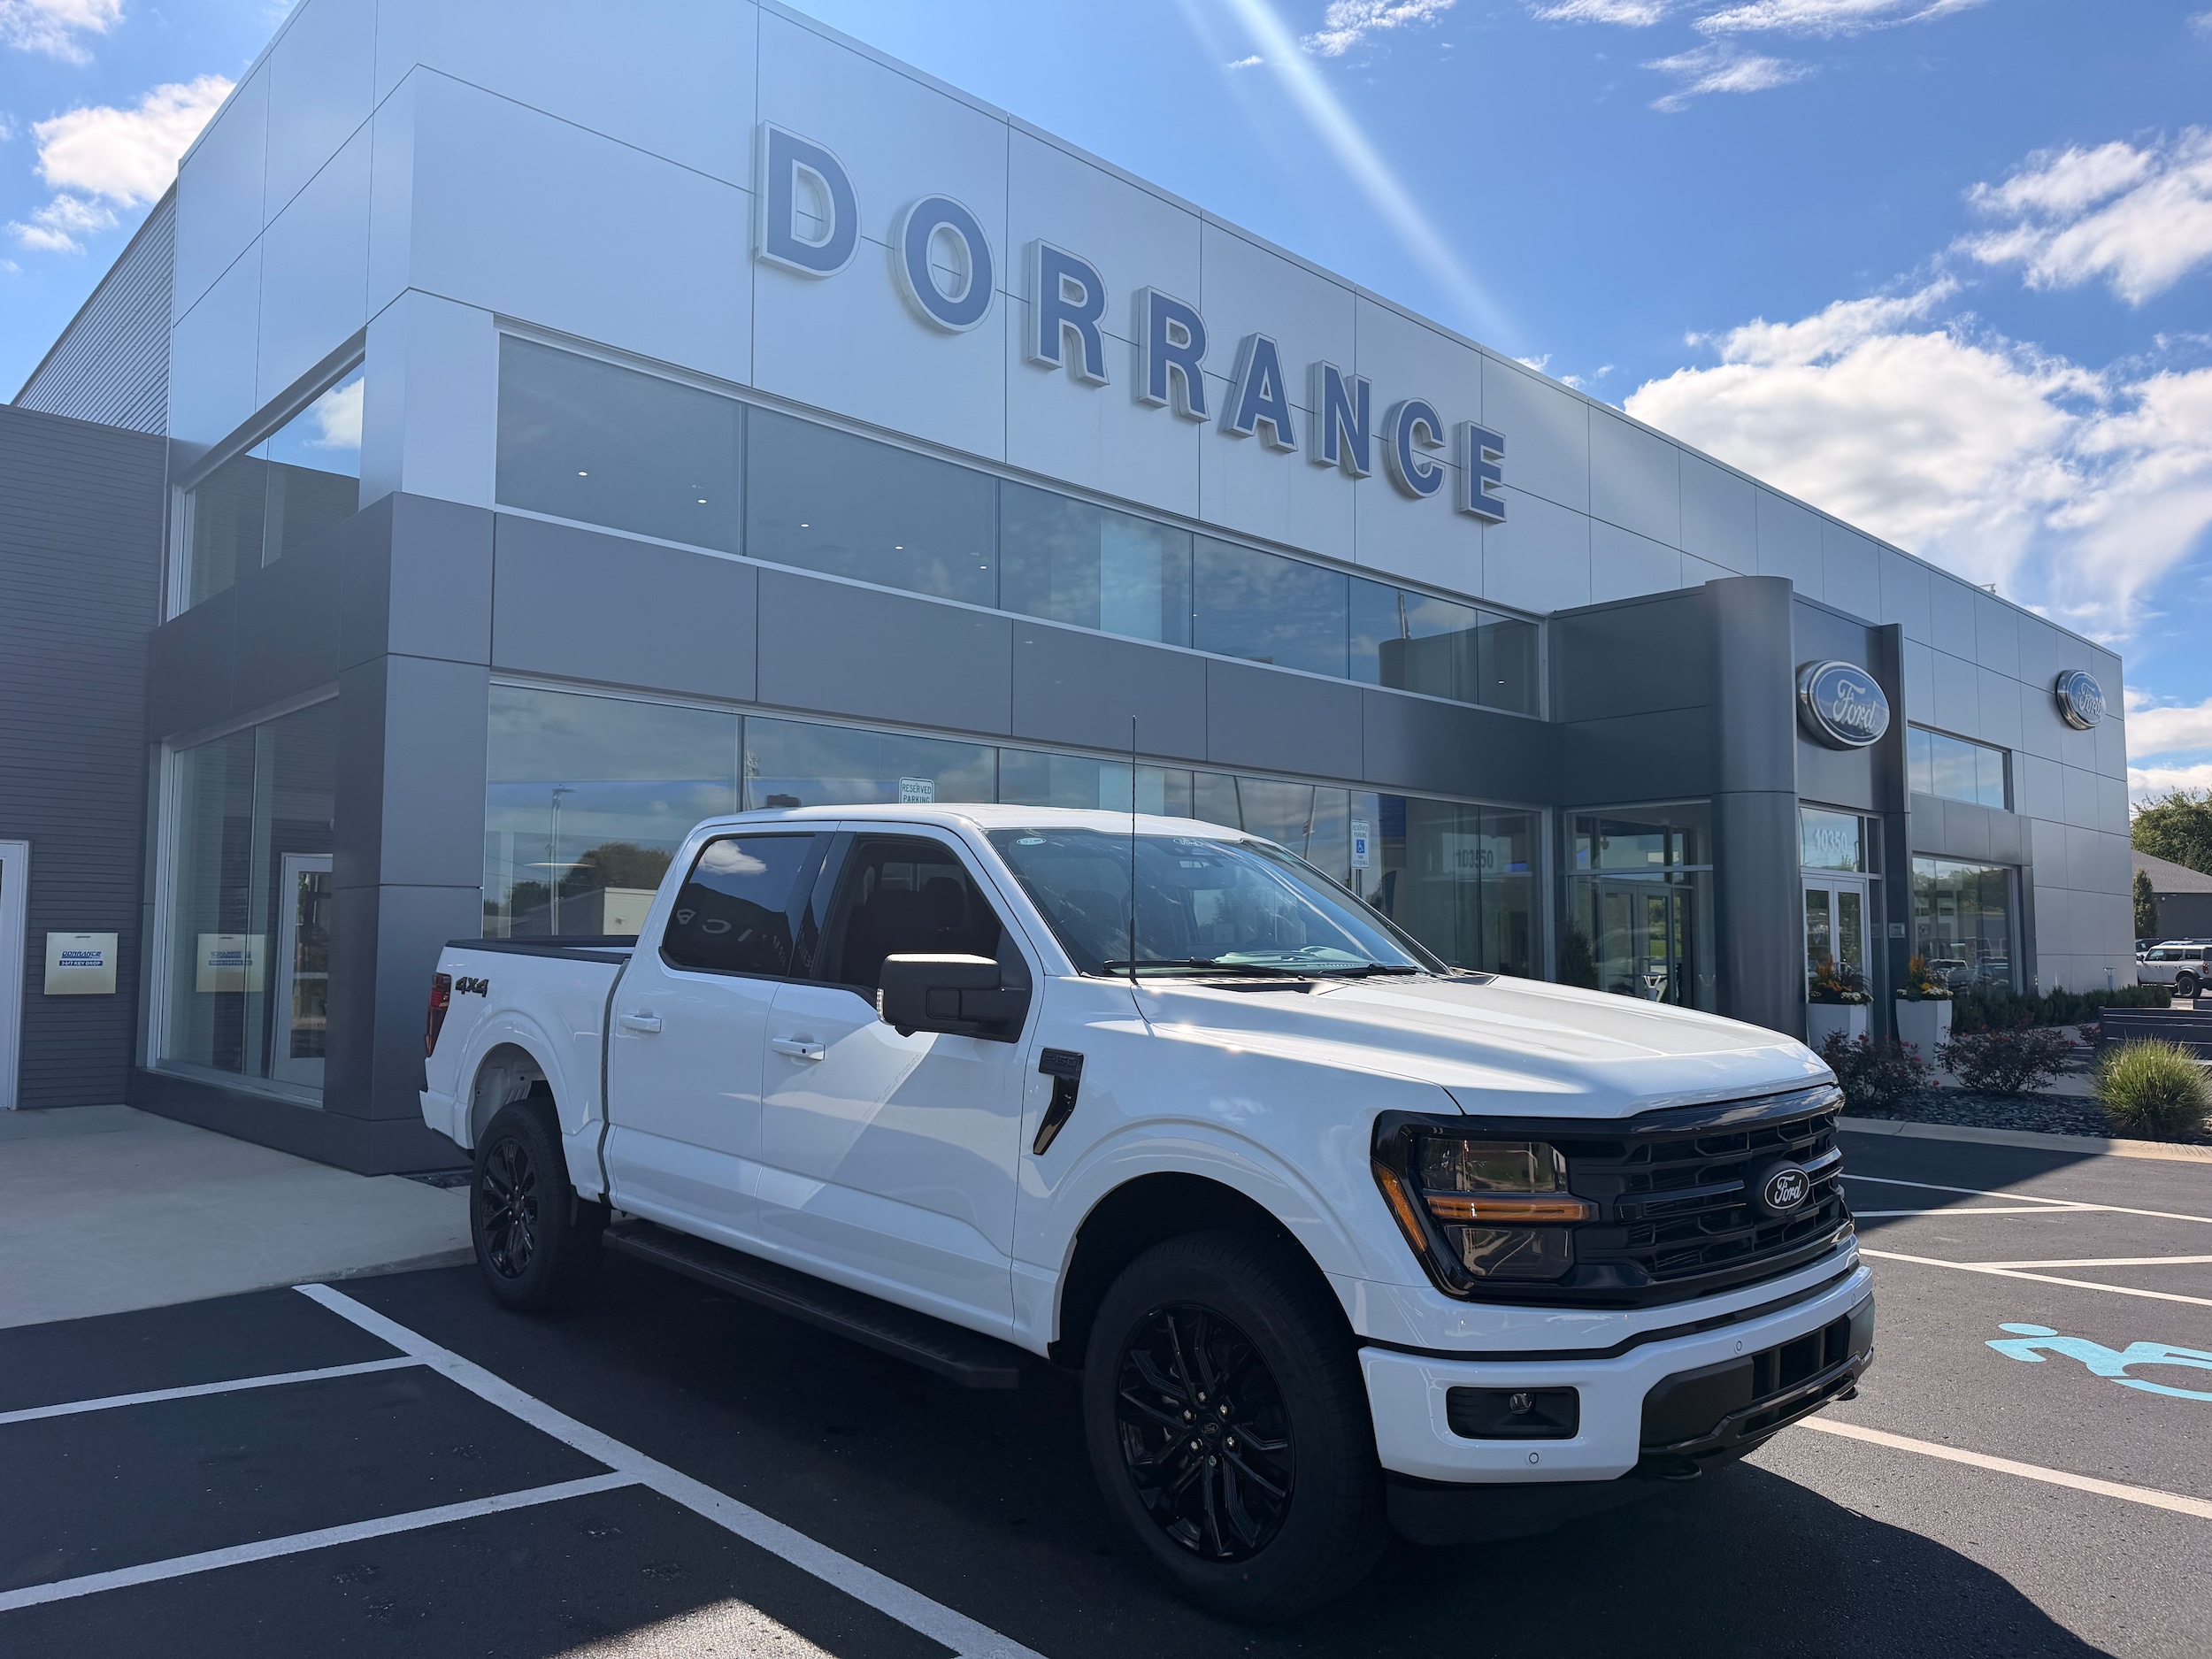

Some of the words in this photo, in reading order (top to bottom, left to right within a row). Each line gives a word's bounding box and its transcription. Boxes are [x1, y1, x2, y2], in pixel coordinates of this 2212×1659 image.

[755, 119, 1507, 524] DORRANCE
[1832, 679, 1876, 730] Ford
[2079, 682, 2102, 716] Ford
[902, 783, 932, 795] RESERVED
[903, 795, 930, 803] PARKING
[1814, 828, 1847, 854] 10350
[1774, 1175, 1802, 1204] Ford
